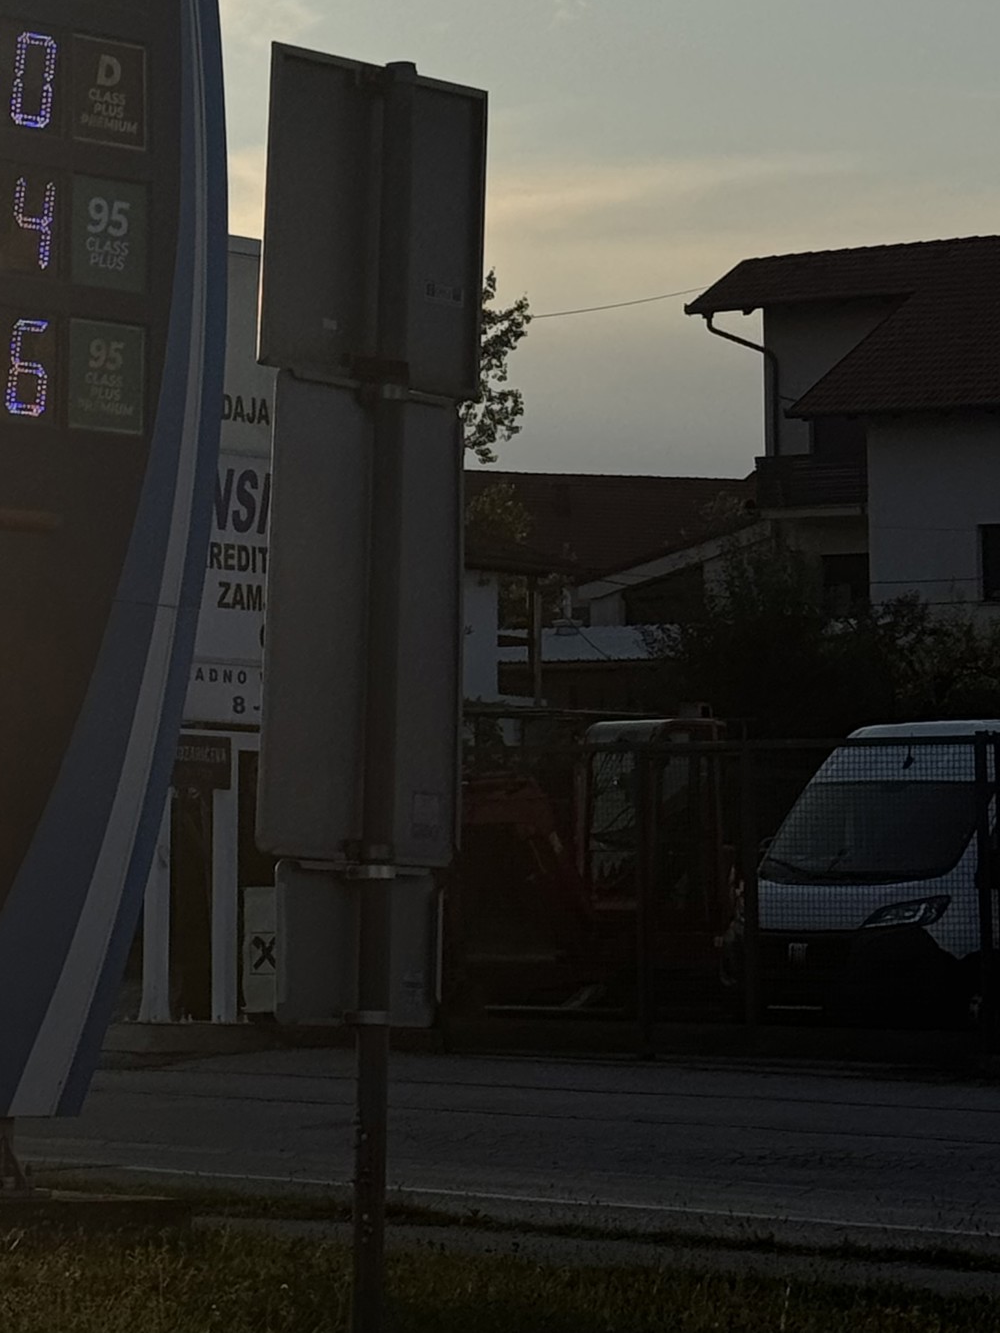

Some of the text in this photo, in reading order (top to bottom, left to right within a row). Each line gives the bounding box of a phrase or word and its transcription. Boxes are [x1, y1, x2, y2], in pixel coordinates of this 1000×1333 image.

[97, 54, 121, 87] D
[88, 88, 126, 106] CLASS
[94, 102, 125, 118] PLUS
[87, 196, 131, 237] 95
[86, 236, 129, 256] CLASS
[90, 253, 126, 271] PLUS
[88, 338, 125, 370] 95
[221, 393, 270, 425] DAJA
[208, 541, 268, 574] REDIT
[217, 581, 265, 612] ZAM
[195, 667, 247, 684] ADNO
